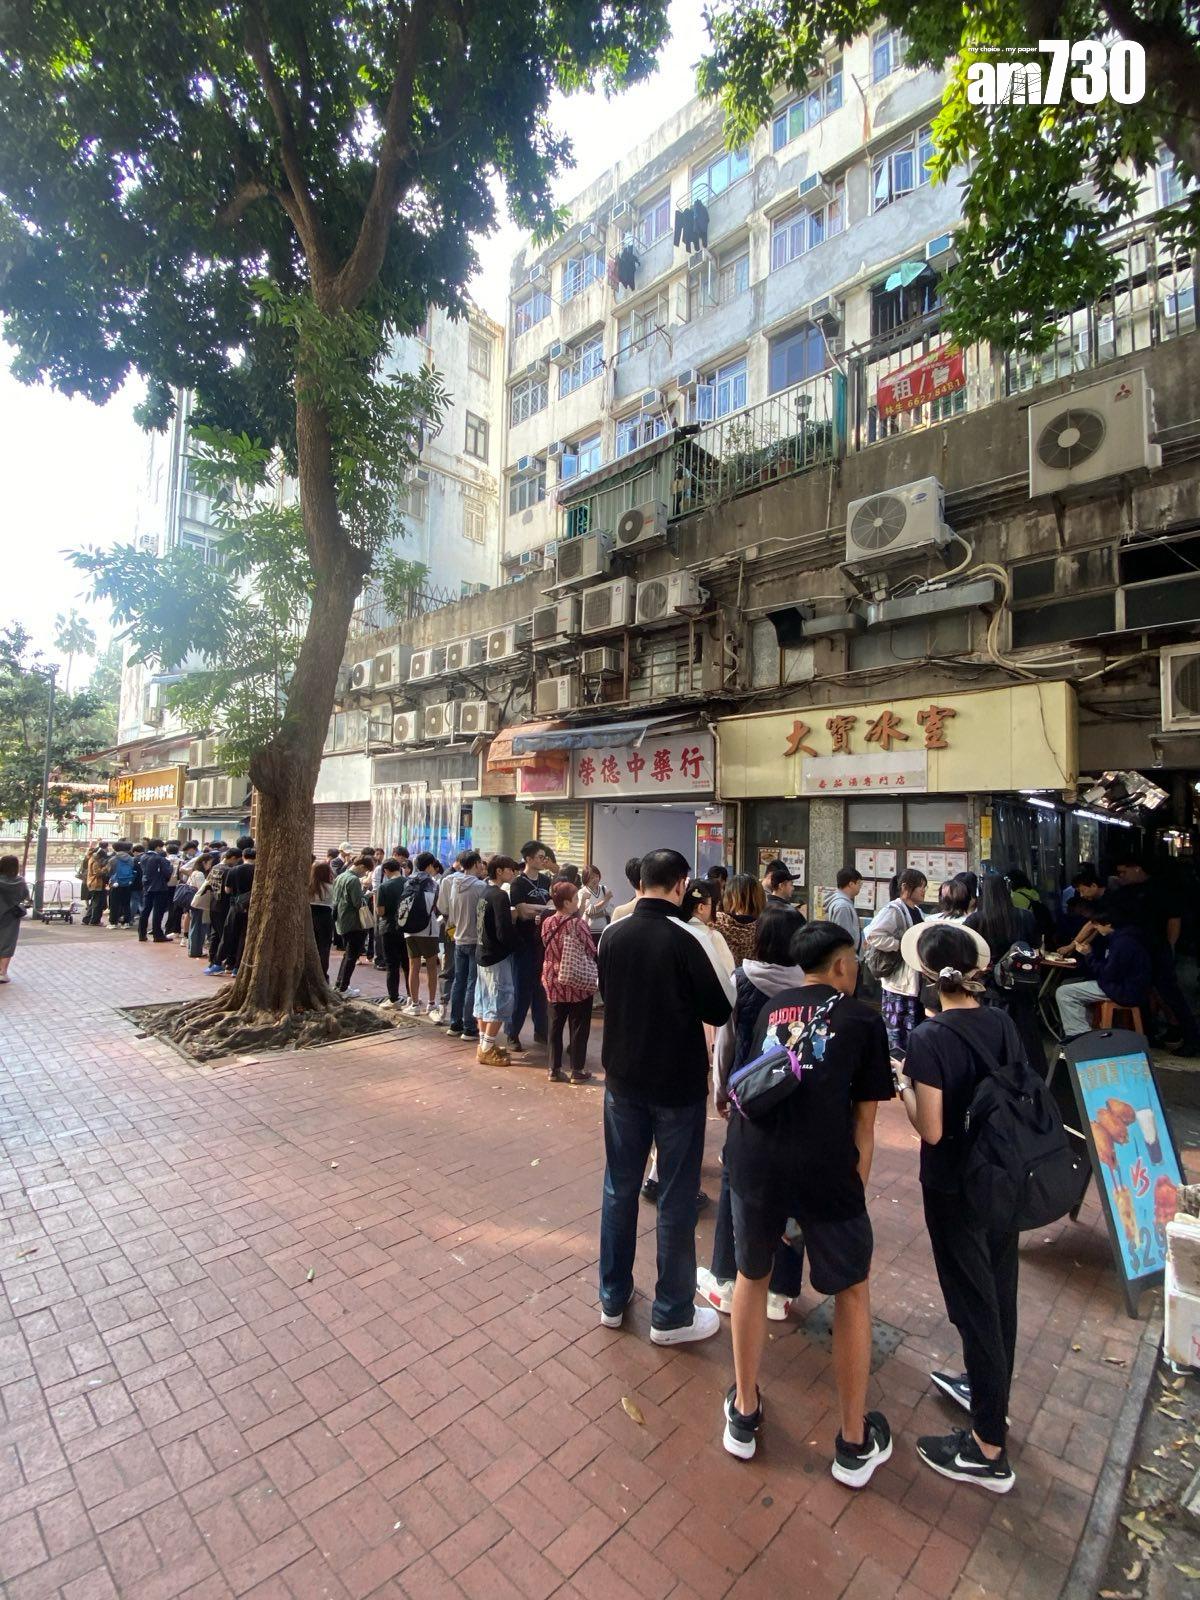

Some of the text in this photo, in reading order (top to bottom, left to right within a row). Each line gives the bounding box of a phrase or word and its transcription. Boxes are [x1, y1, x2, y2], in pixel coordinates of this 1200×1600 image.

[783, 704, 957, 757] 大寶冰室
[577, 746, 705, 787] 榮德中藥行
[1129, 1157, 1150, 1199] VS
